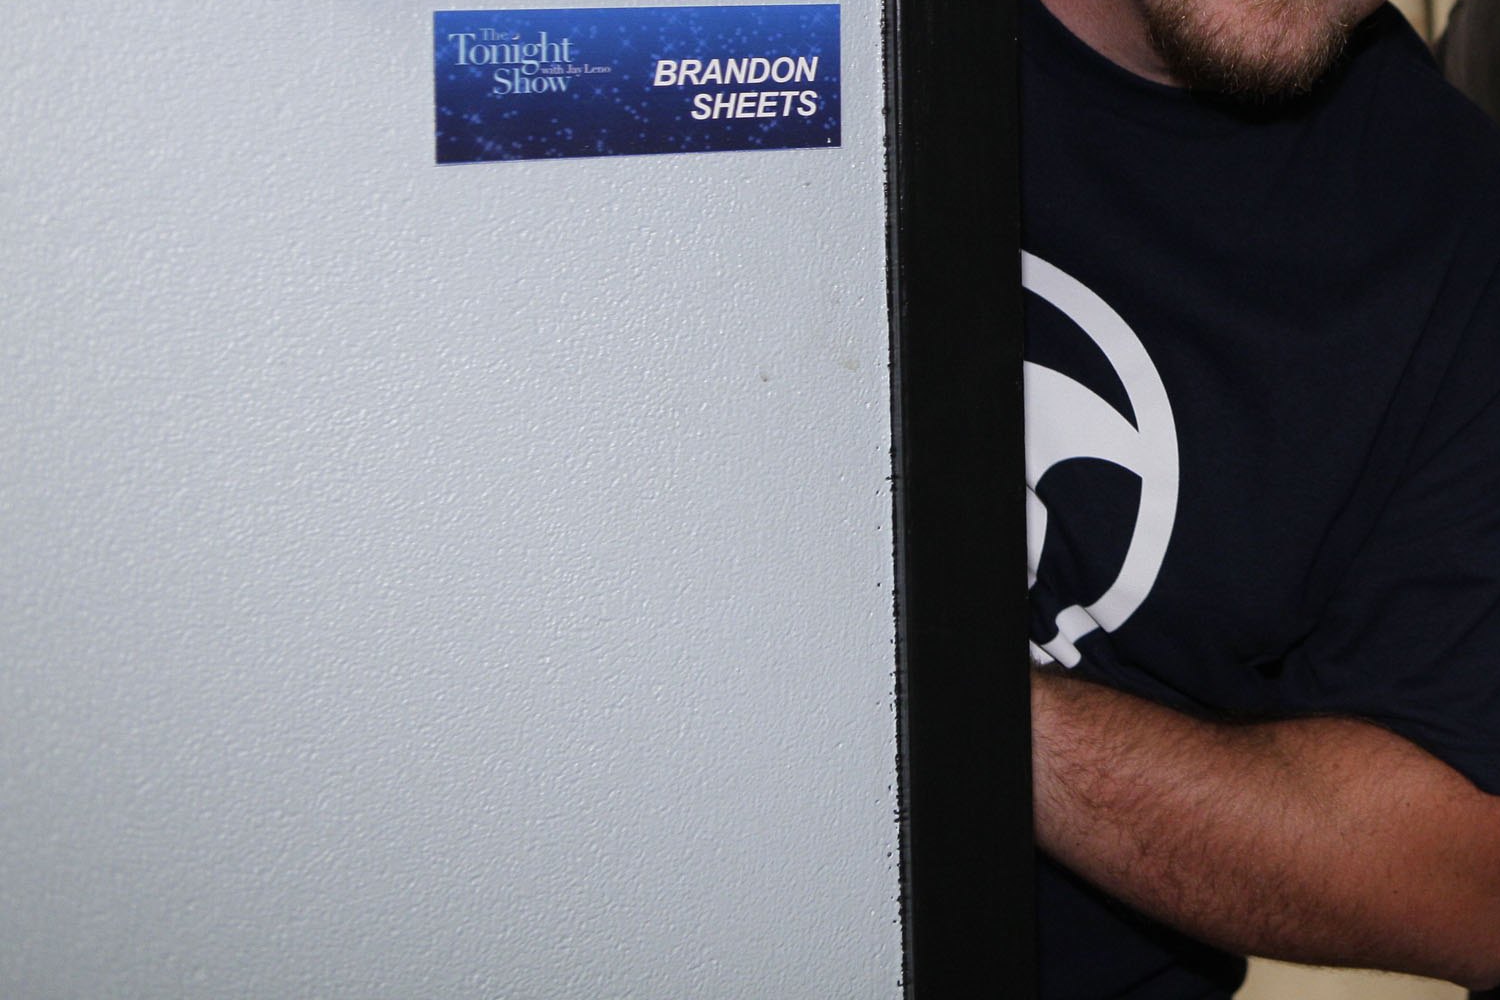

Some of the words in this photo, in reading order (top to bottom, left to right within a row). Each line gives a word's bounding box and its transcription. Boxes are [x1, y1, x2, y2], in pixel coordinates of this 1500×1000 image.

[480, 28, 509, 41] The
[448, 31, 574, 76] Tonight
[493, 68, 572, 95] Show
[541, 65, 564, 75] with
[566, 65, 582, 77] Jay
[584, 64, 611, 74] Leno
[653, 56, 819, 86] BRANDON
[691, 91, 818, 120] SHEETS
